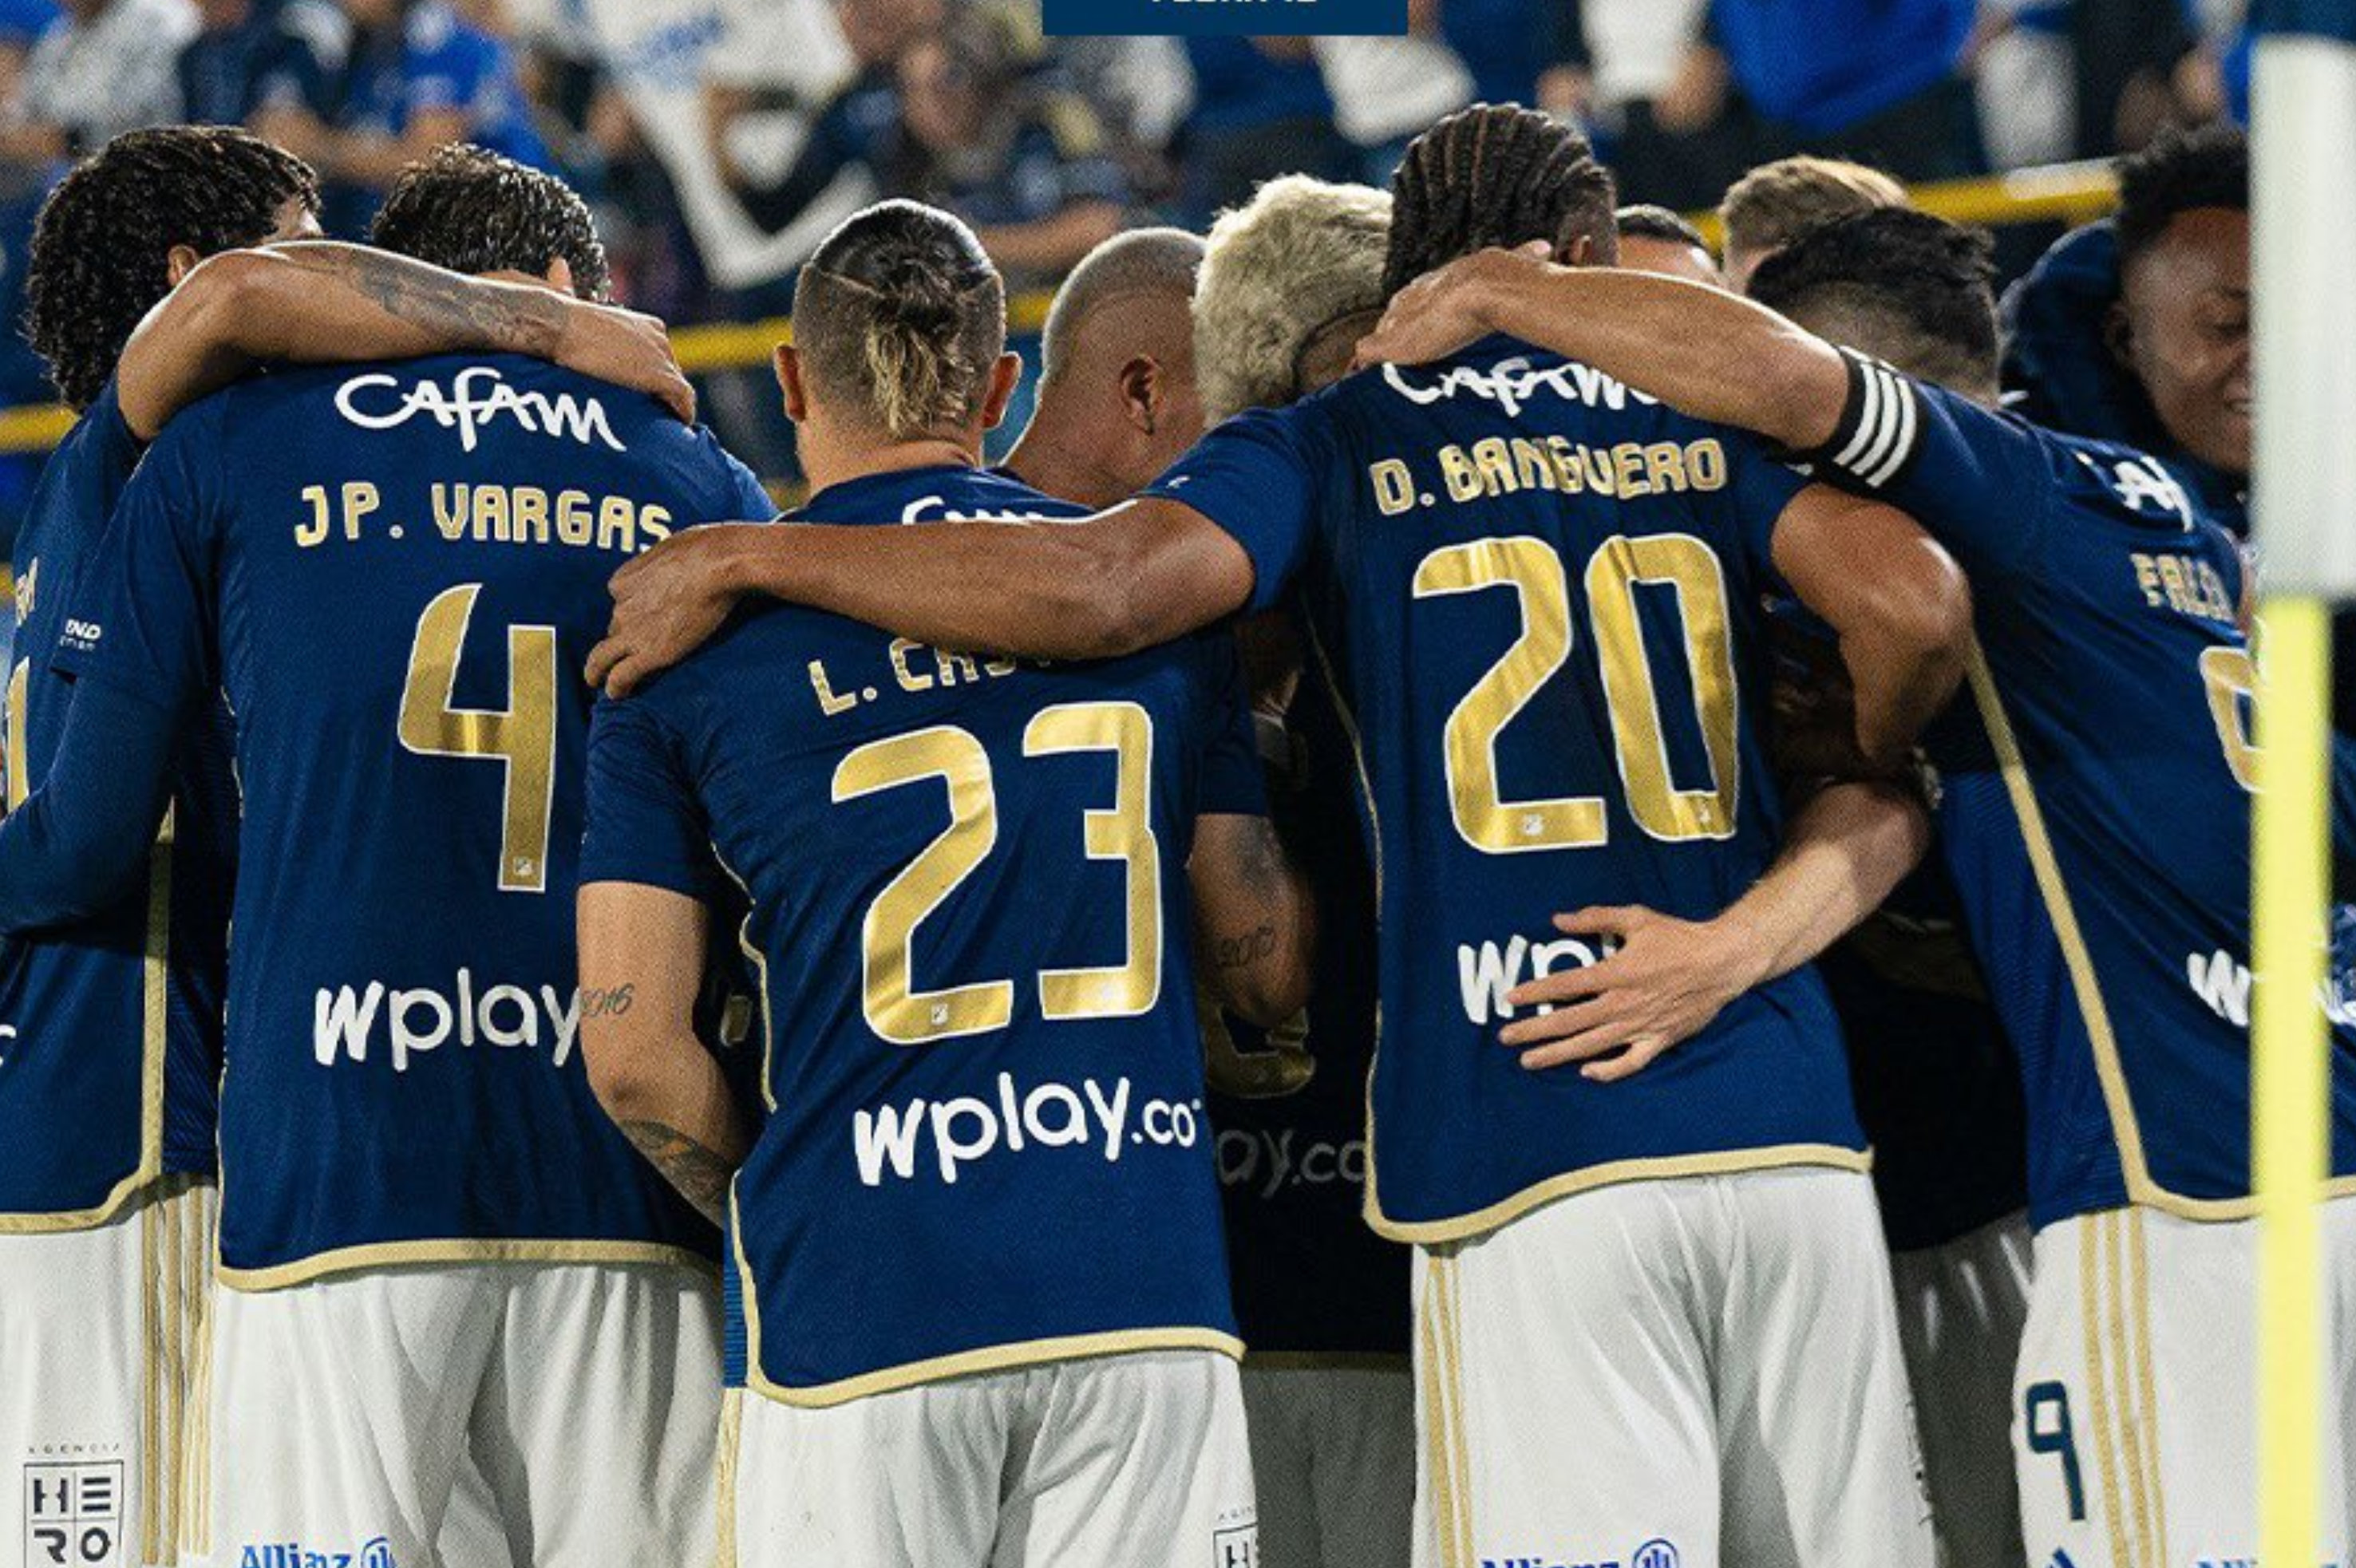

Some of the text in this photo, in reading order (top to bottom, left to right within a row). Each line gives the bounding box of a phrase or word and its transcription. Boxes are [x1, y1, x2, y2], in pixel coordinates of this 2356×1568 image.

[294, 481, 672, 553] JP. VARGAS
[1369, 435, 1726, 515] D. BANGUERO
[397, 583, 557, 894] 4
[808, 659, 877, 717] L.
[1413, 533, 1740, 855] 20
[831, 701, 1164, 1045] 23
[2026, 1380, 2086, 1521] 9
